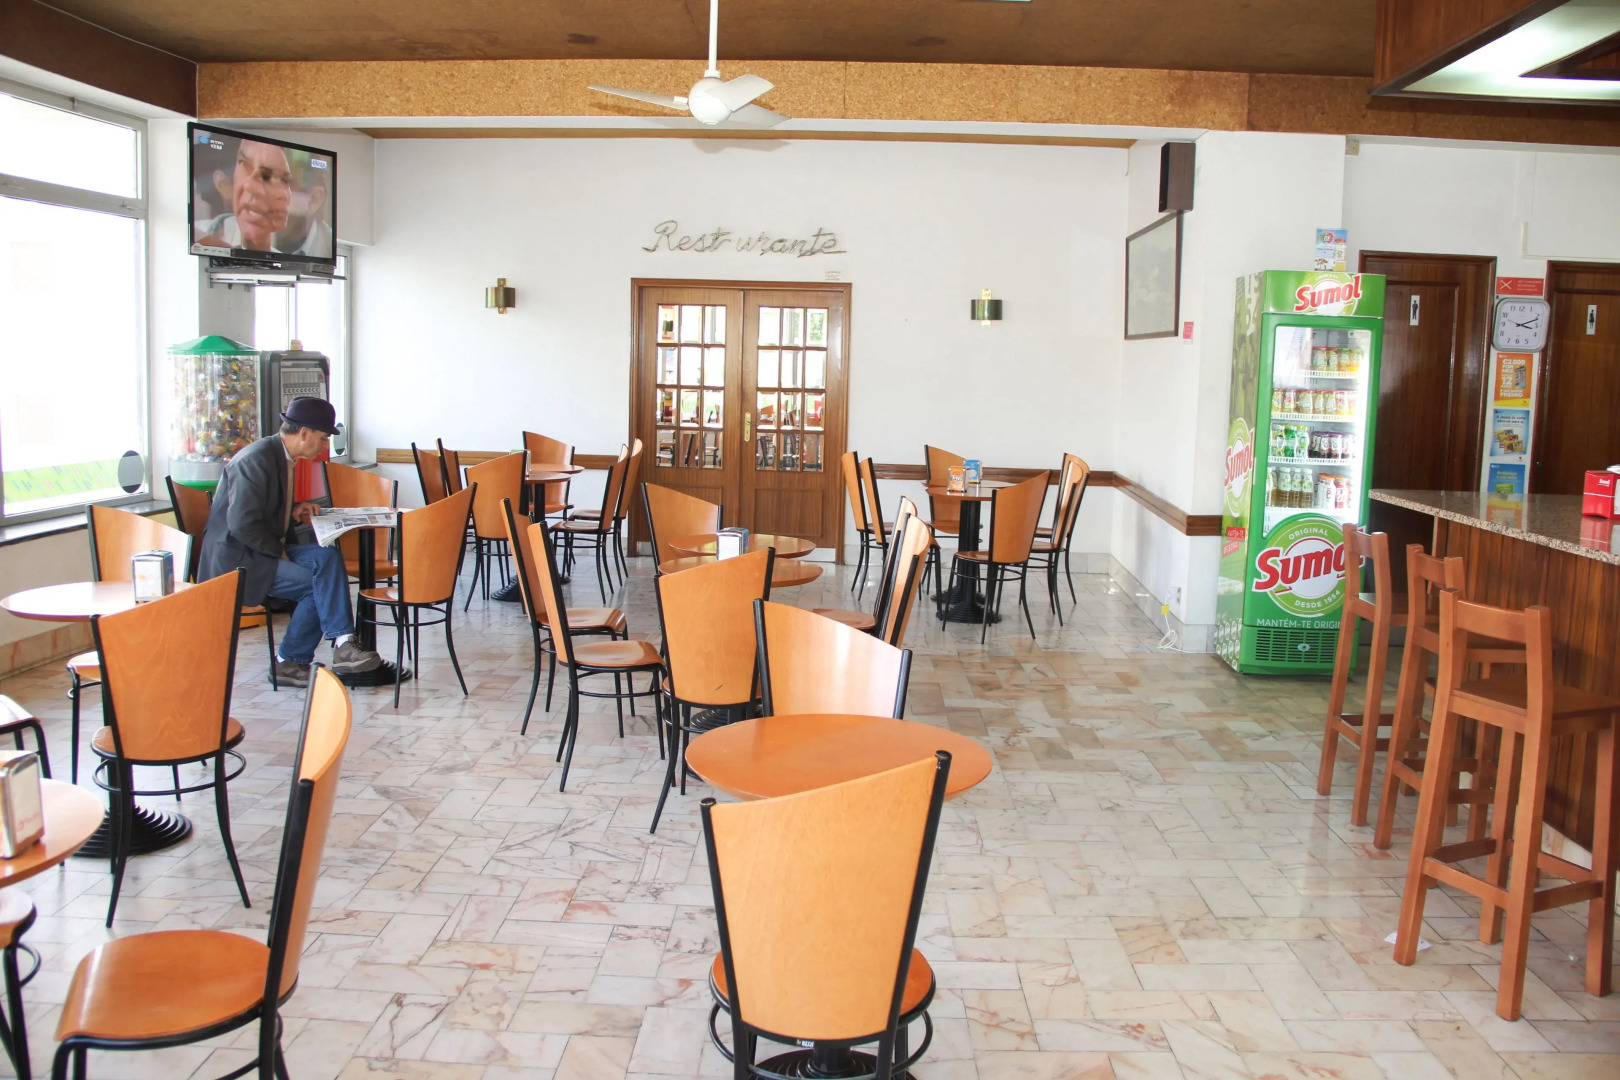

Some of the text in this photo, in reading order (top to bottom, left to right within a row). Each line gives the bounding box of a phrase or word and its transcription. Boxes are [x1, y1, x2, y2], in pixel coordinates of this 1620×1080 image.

[1294, 275, 1361, 311] Sumol
[1501, 375, 1513, 384] 12
[1224, 429, 1254, 486] Sumol
[1288, 527, 1328, 540] ORIGINAL
[1254, 529, 1363, 590] Sumo
[1324, 590, 1340, 604] 1954
[1295, 600, 1321, 608] DESDE
[1256, 618, 1311, 629] MANTÉM-TE
